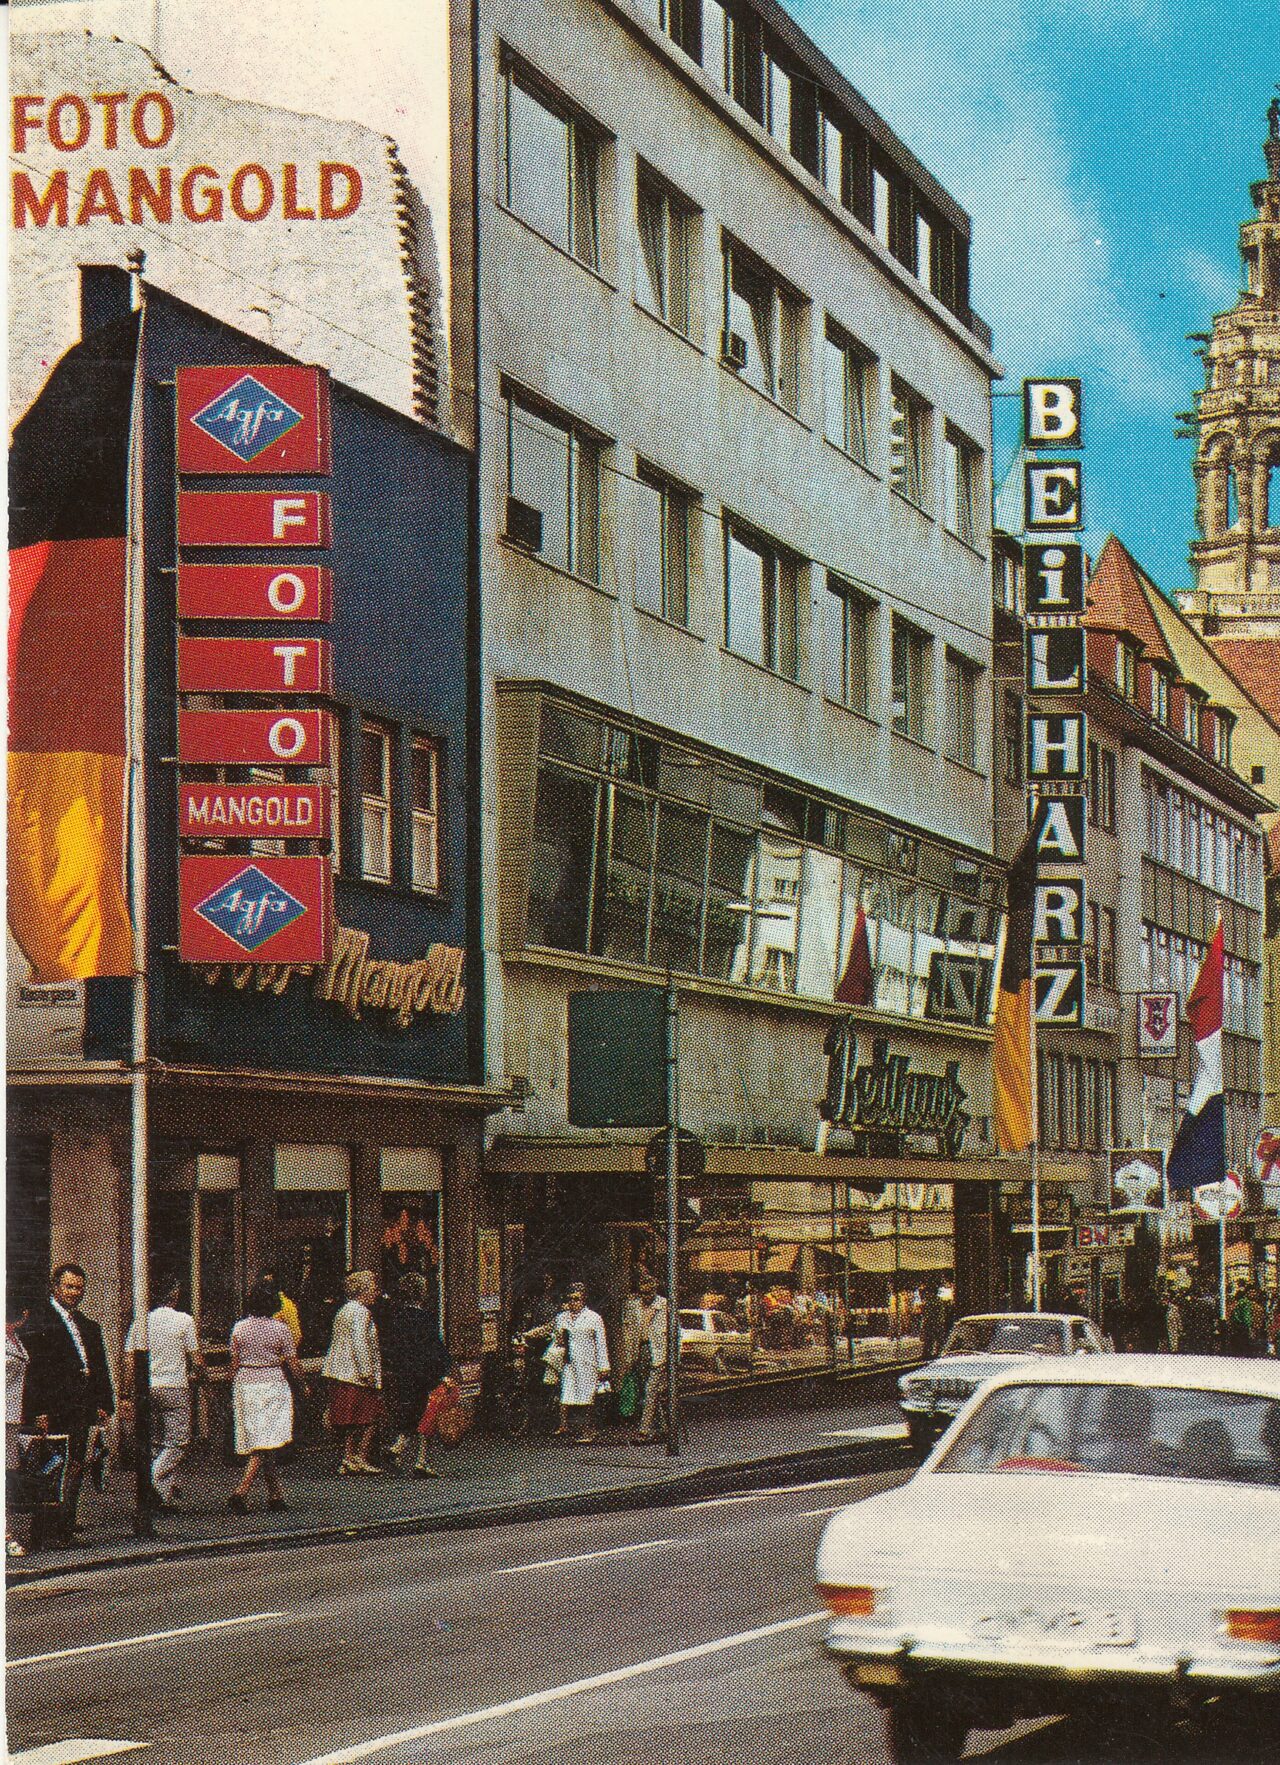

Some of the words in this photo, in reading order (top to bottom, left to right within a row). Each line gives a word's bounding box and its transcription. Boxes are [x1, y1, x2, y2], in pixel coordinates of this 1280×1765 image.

[11, 91, 175, 153] FOTO
[11, 161, 364, 230] MANGOLD
[206, 398, 283, 445] Agfa
[268, 499, 307, 758] FOTO
[187, 796, 313, 828] MANGOLD
[209, 888, 289, 936] Agfa
